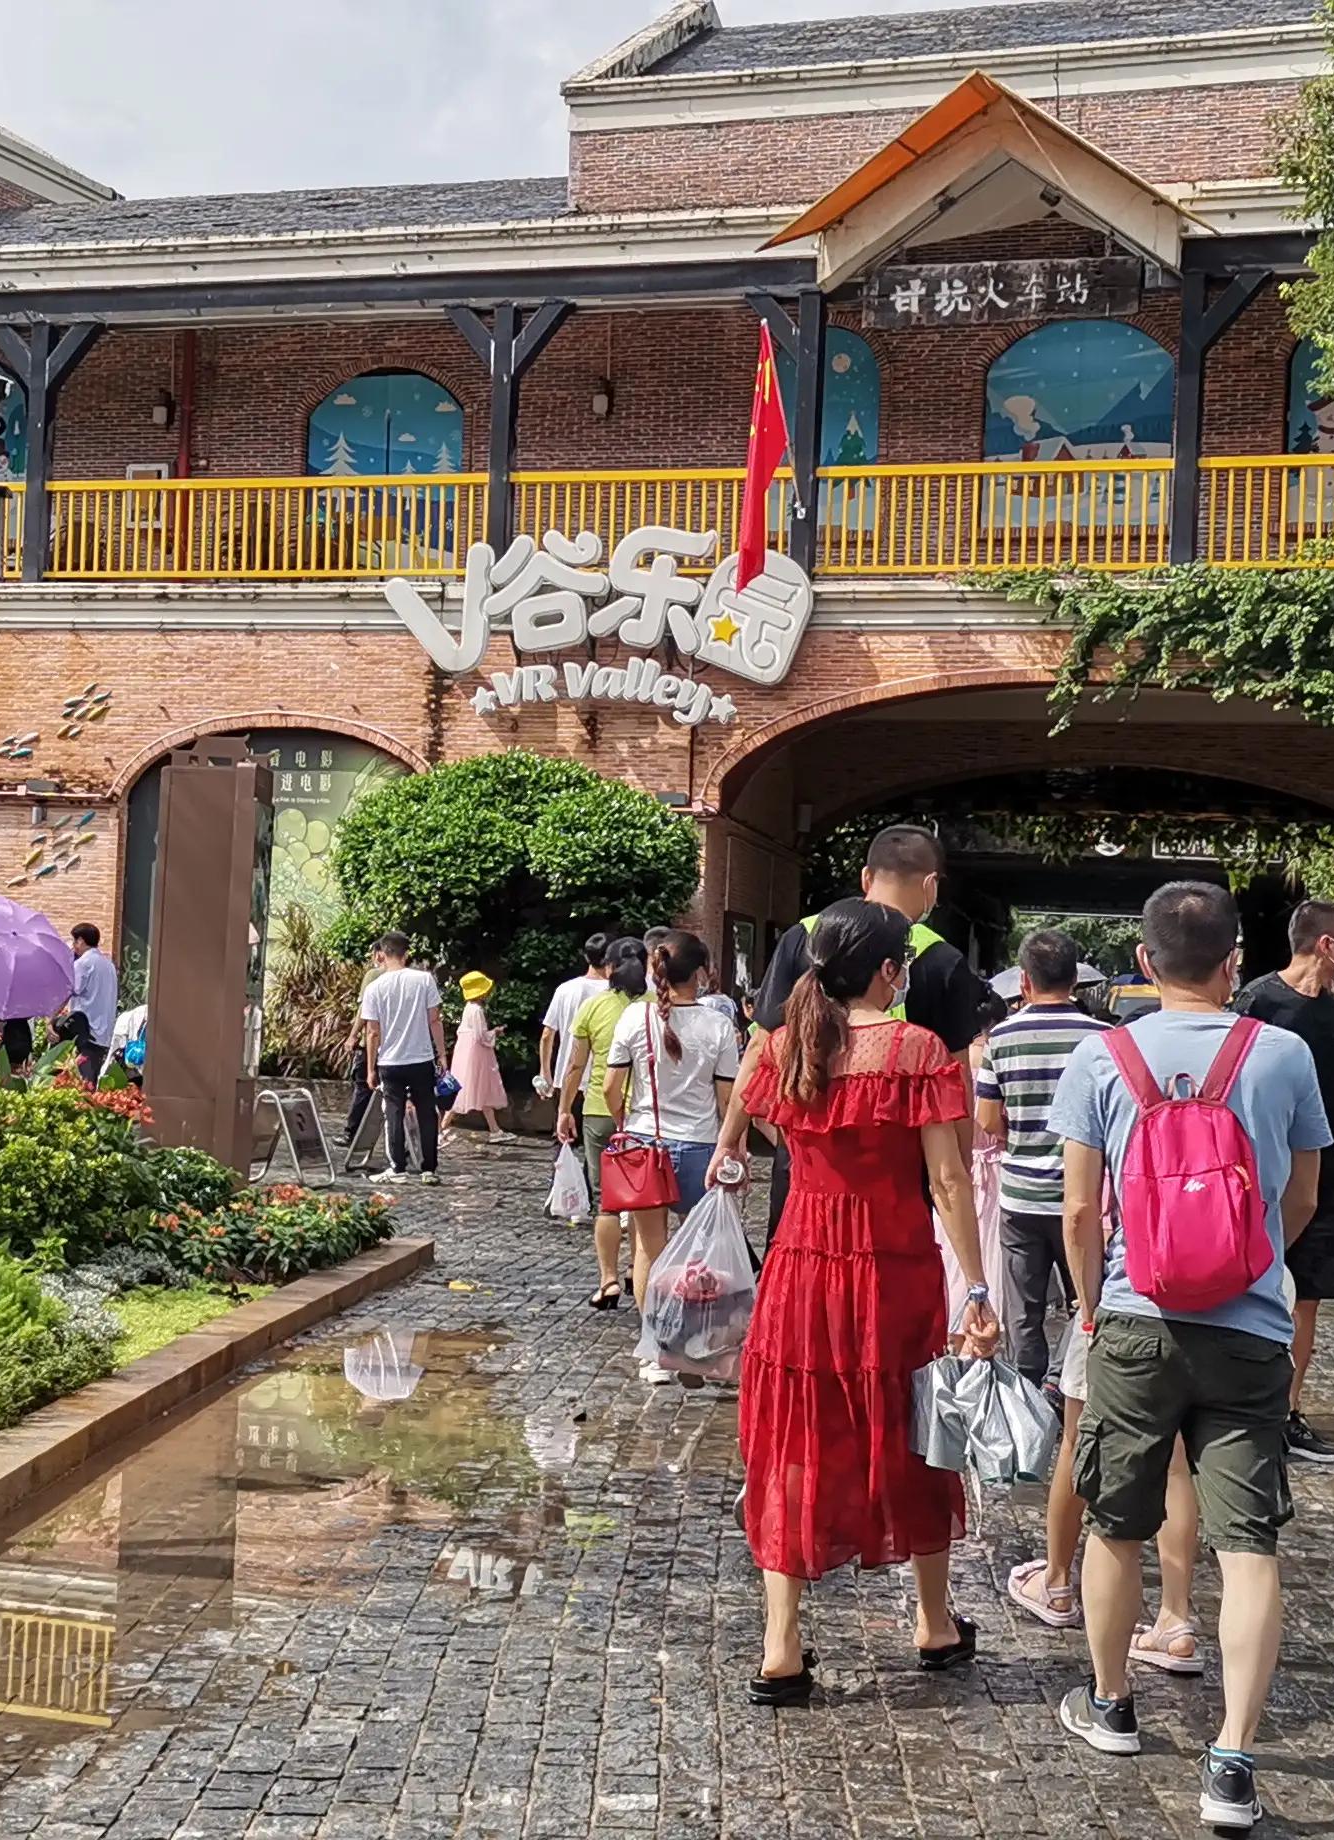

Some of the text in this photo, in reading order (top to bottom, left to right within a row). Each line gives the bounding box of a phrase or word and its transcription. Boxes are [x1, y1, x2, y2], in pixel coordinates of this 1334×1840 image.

[889, 271, 1090, 317] 甘坑火车站
[490, 656, 714, 726] VR Valley
